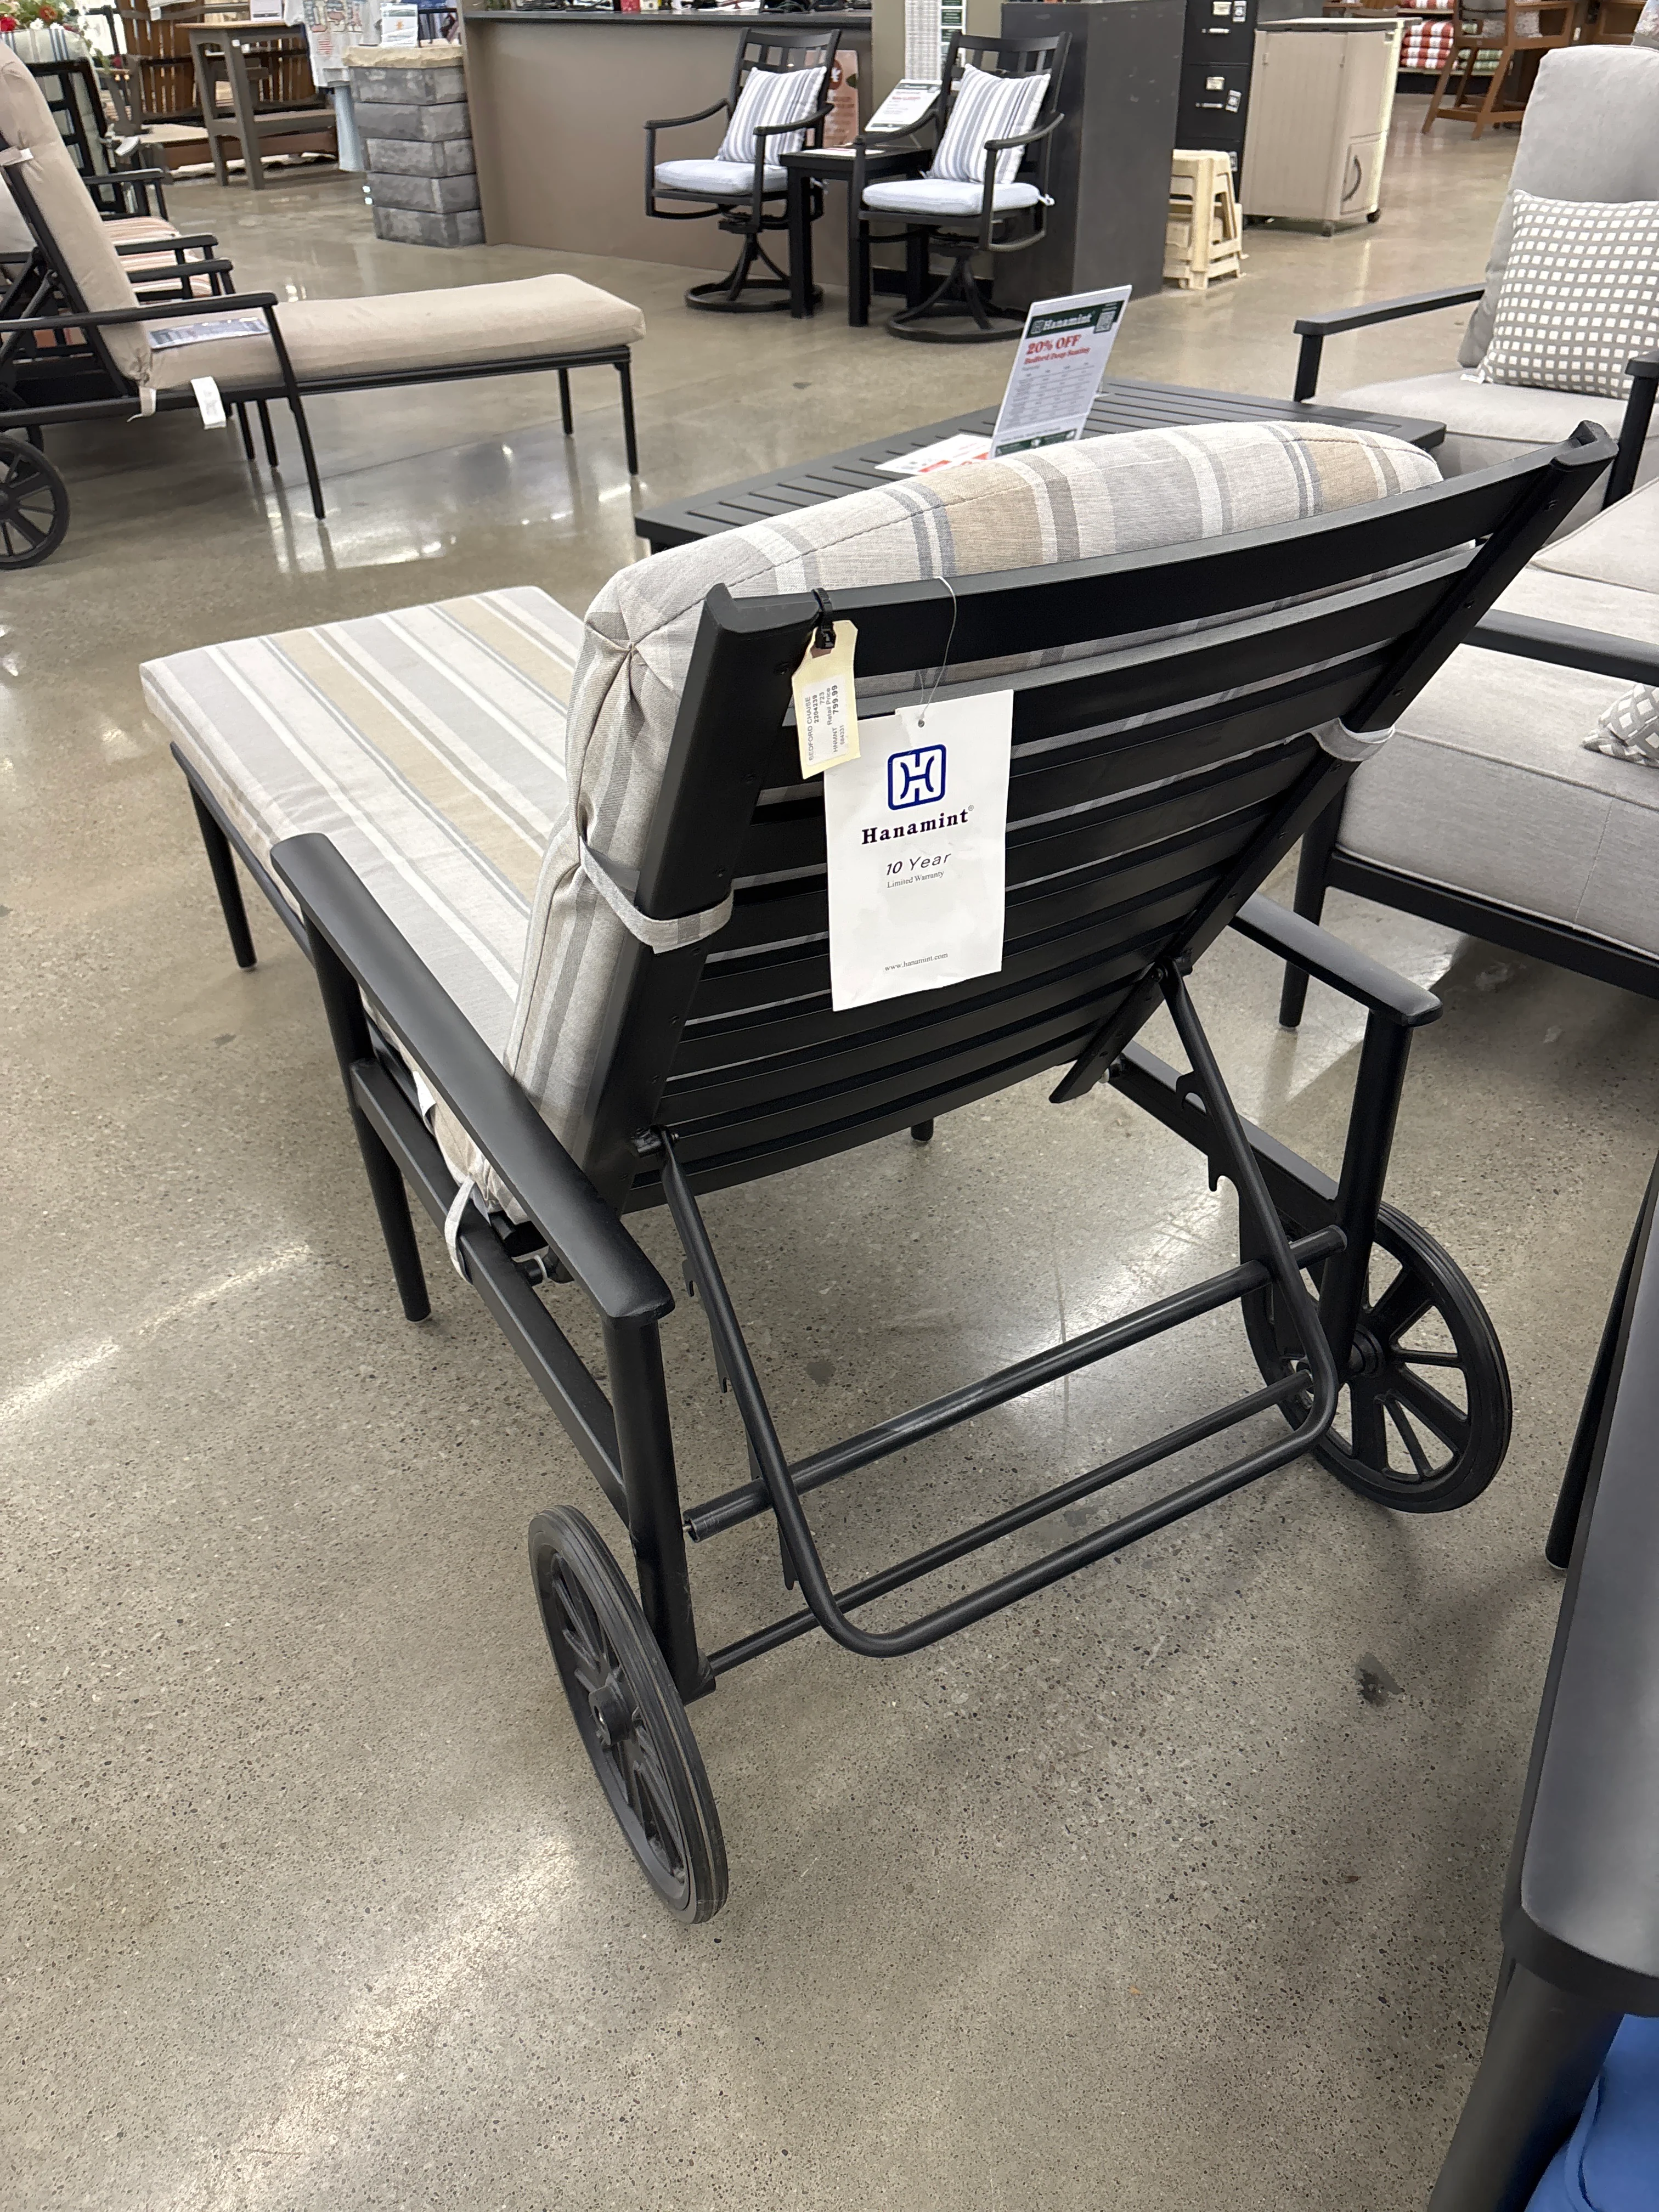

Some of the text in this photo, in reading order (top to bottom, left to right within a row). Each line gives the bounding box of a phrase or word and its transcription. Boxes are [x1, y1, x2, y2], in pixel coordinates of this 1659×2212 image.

[1026, 334, 1081, 354] 20% OFF
[886, 854, 952, 876] 10 Year
[887, 871, 944, 888] Limited Warranty
[884, 953, 948, 970] www.hanamint.com
